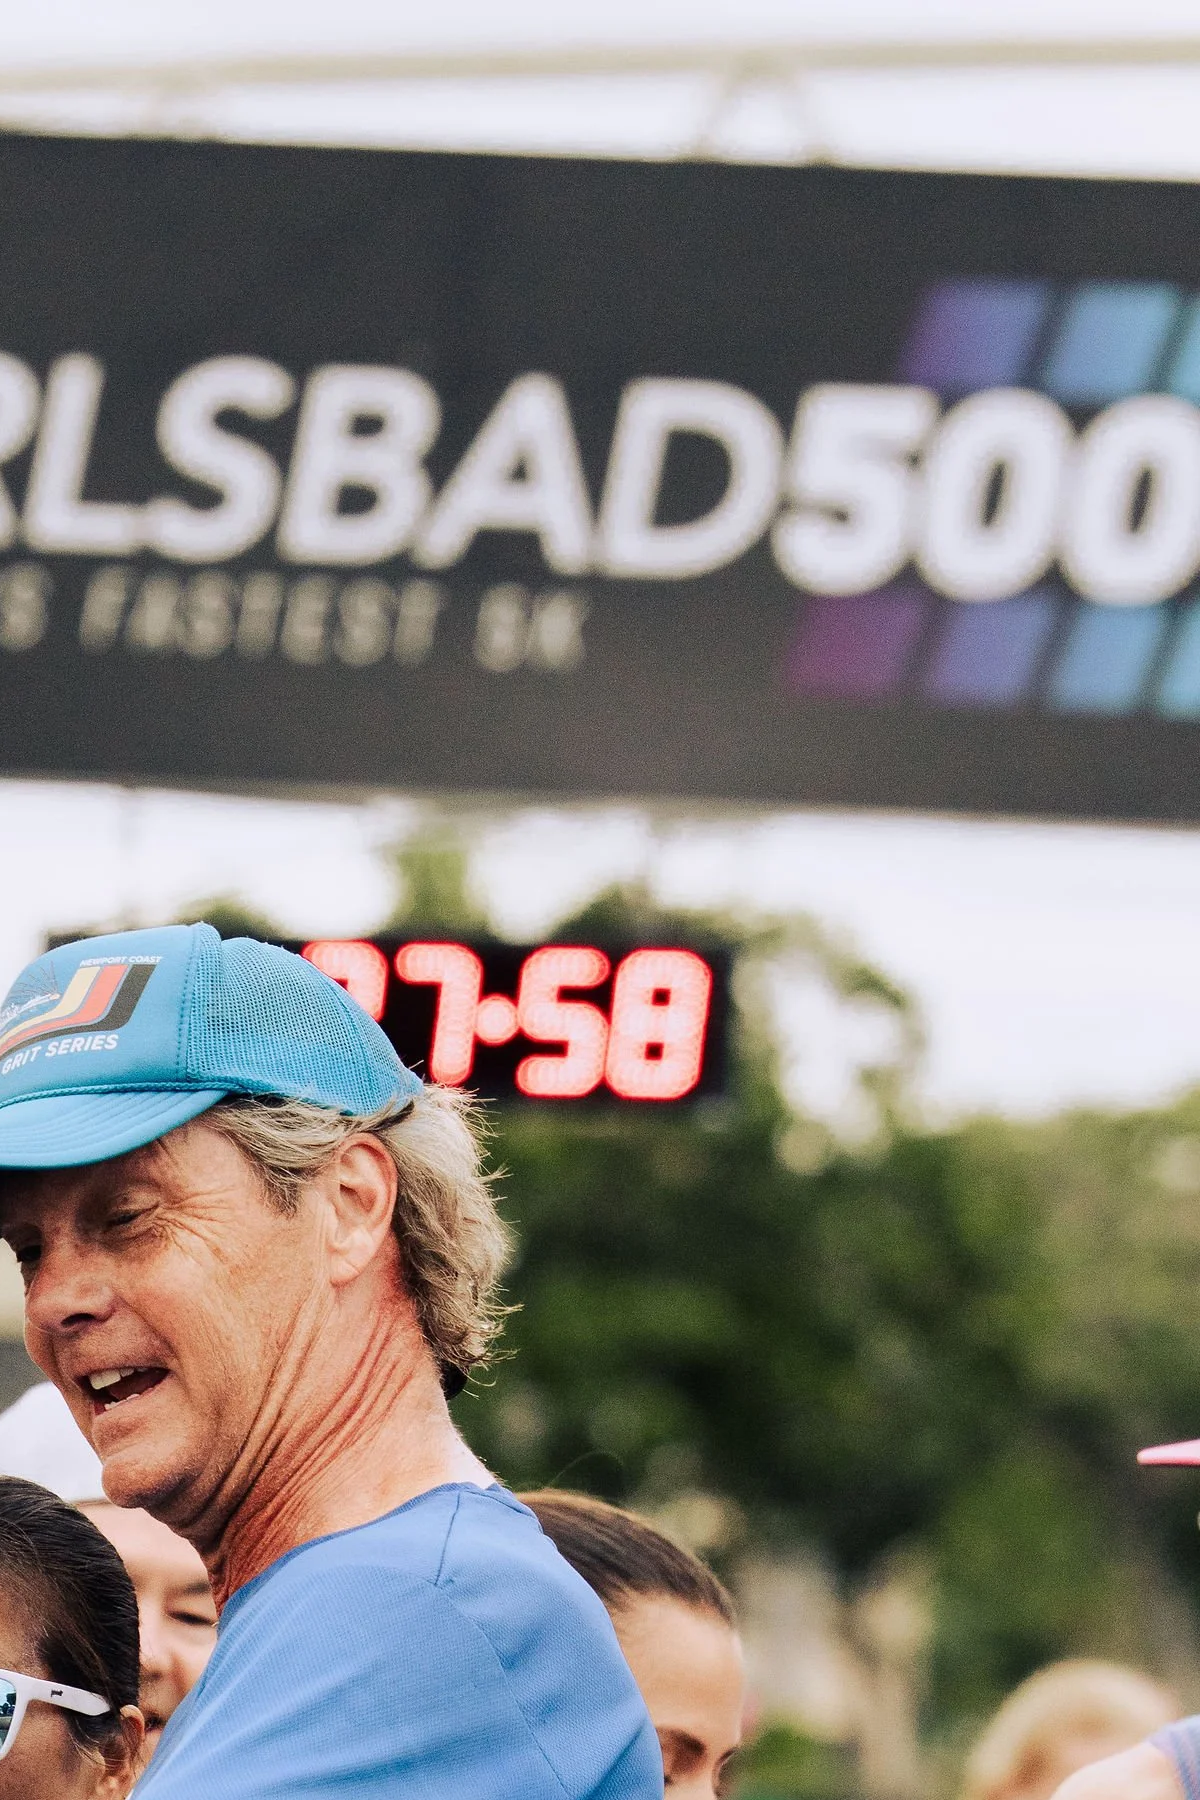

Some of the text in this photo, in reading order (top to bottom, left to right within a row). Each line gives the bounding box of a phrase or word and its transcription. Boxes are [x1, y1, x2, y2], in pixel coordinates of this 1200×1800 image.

[79, 955, 163, 967] NEWPORT COAST
[1, 1046, 42, 1075] GRIT
[45, 1034, 119, 1057] SERIES
